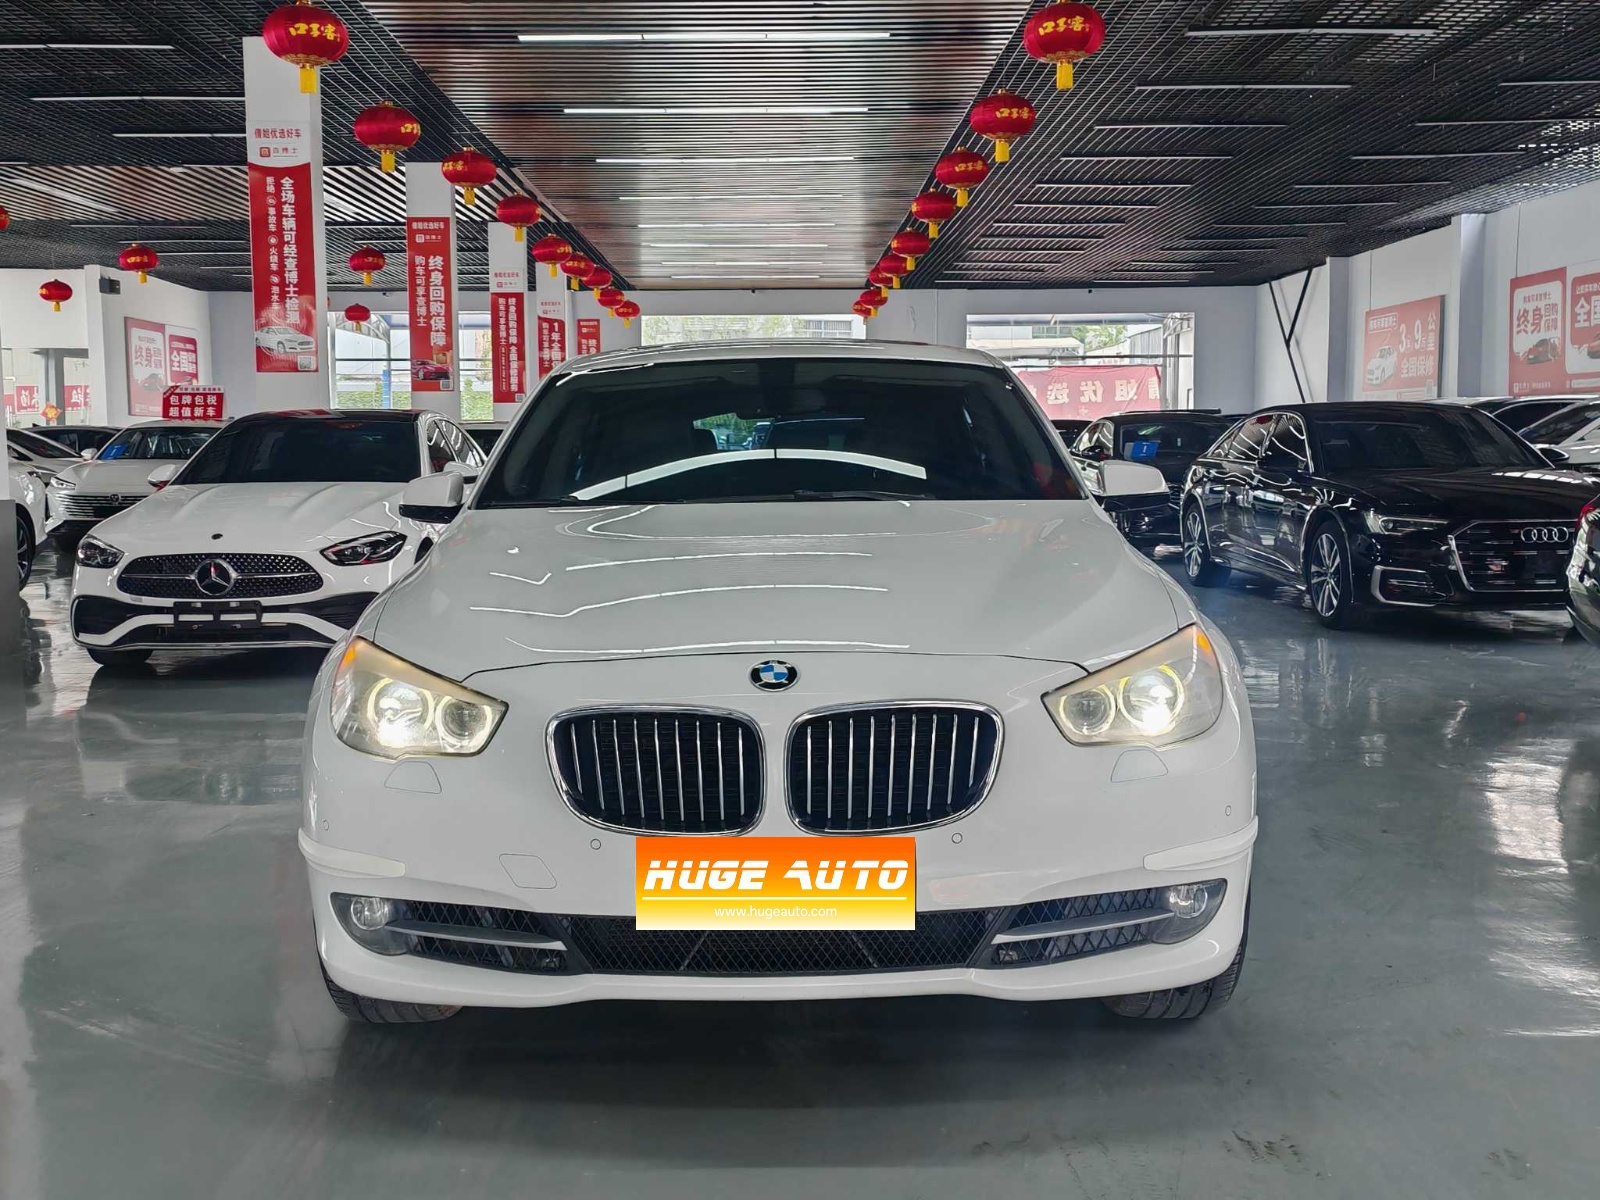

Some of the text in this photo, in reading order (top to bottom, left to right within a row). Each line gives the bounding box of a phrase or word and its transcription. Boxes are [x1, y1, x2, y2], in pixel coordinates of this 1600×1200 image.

[428, 255, 446, 347] 终身回购保障
[1516, 305, 1543, 335] 终身
